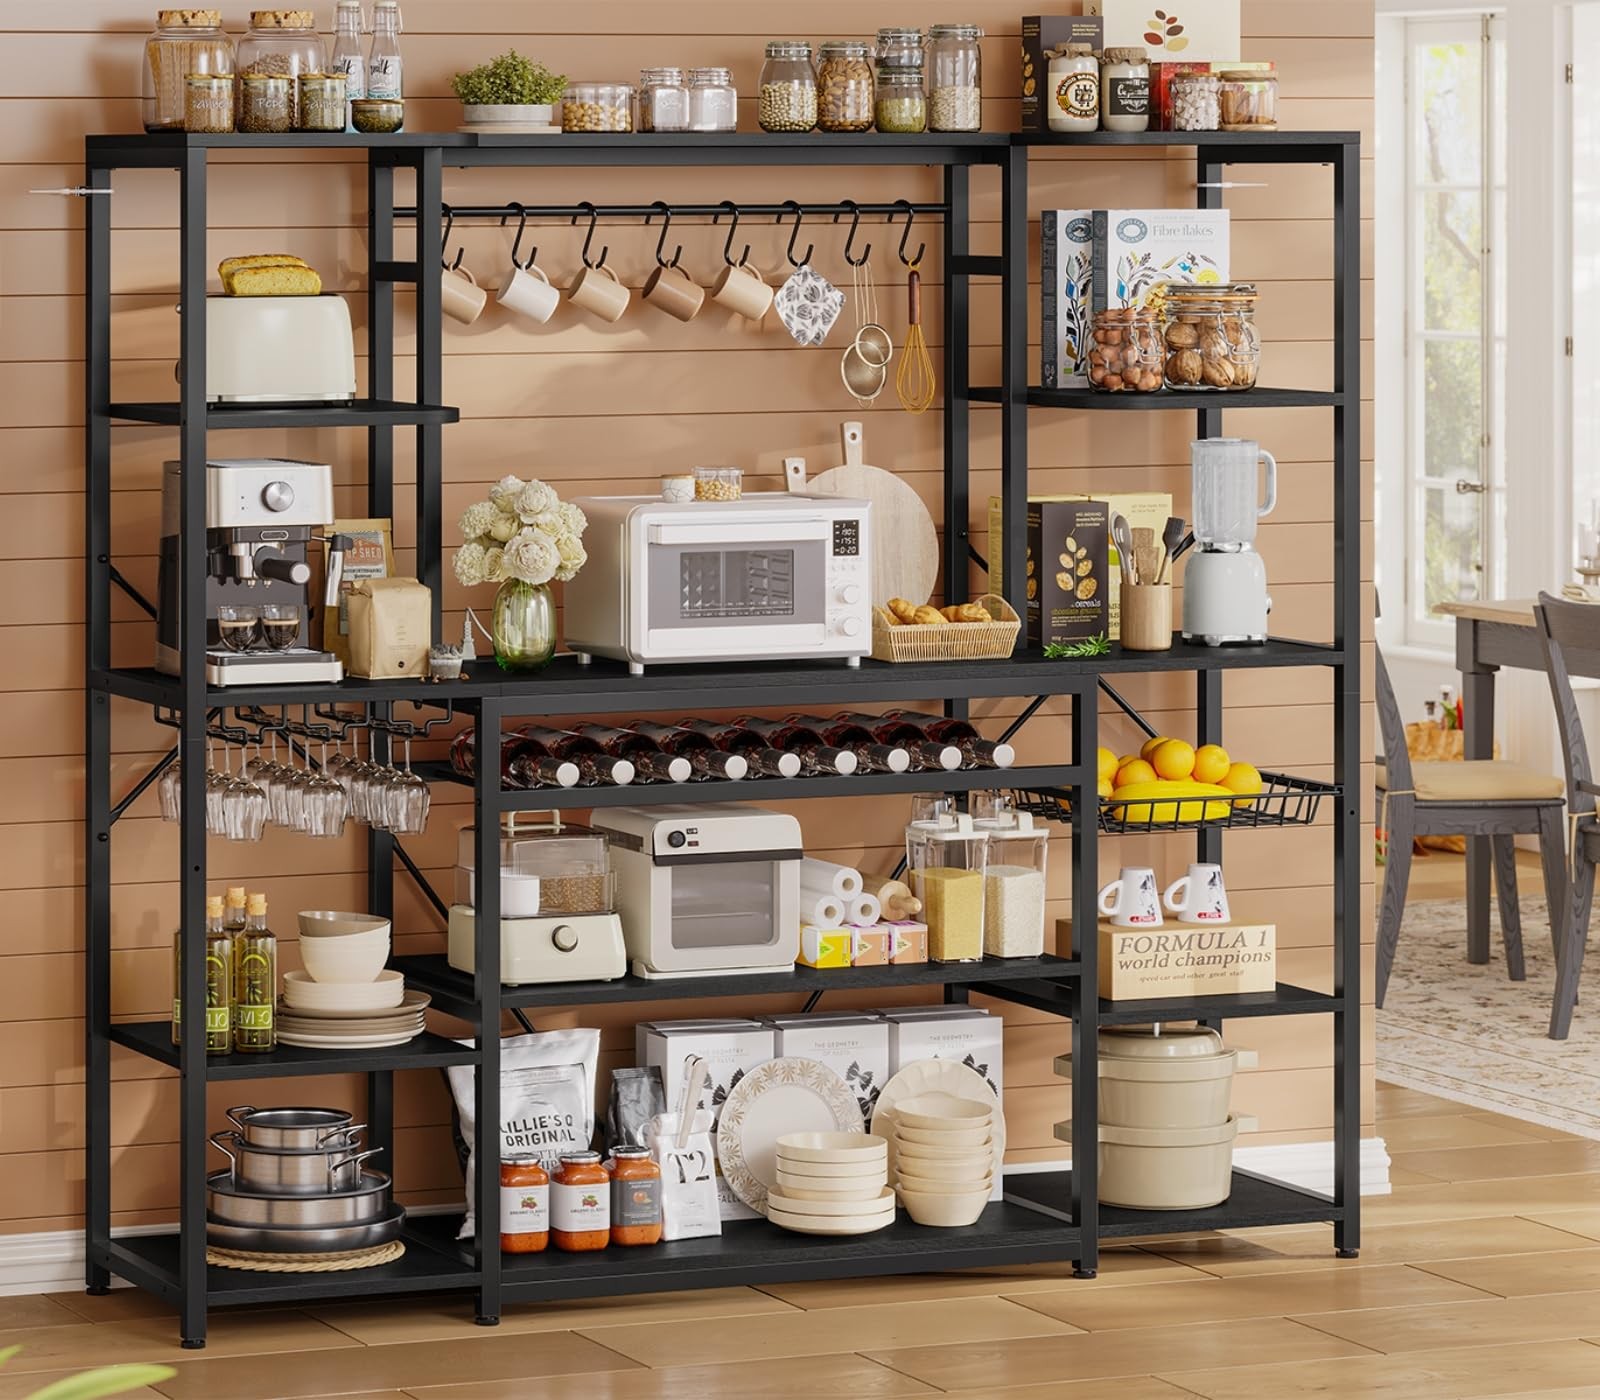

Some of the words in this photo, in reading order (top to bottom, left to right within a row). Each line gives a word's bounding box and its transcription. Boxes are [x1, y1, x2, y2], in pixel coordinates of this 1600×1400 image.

[1153, 223, 1180, 236] Fibre
[1183, 223, 1214, 236] flakes
[1118, 931, 1248, 954] FORMULA
[1258, 930, 1267, 947] 1
[1118, 953, 1170, 970] world
[1175, 950, 1272, 968] champions
[1139, 975, 1159, 983] speed
[1209, 971, 1227, 979] great
[565, 1114, 573, 1127] Q
[505, 1129, 576, 1147] ORIGINAL
[667, 1150, 710, 1184] T2
